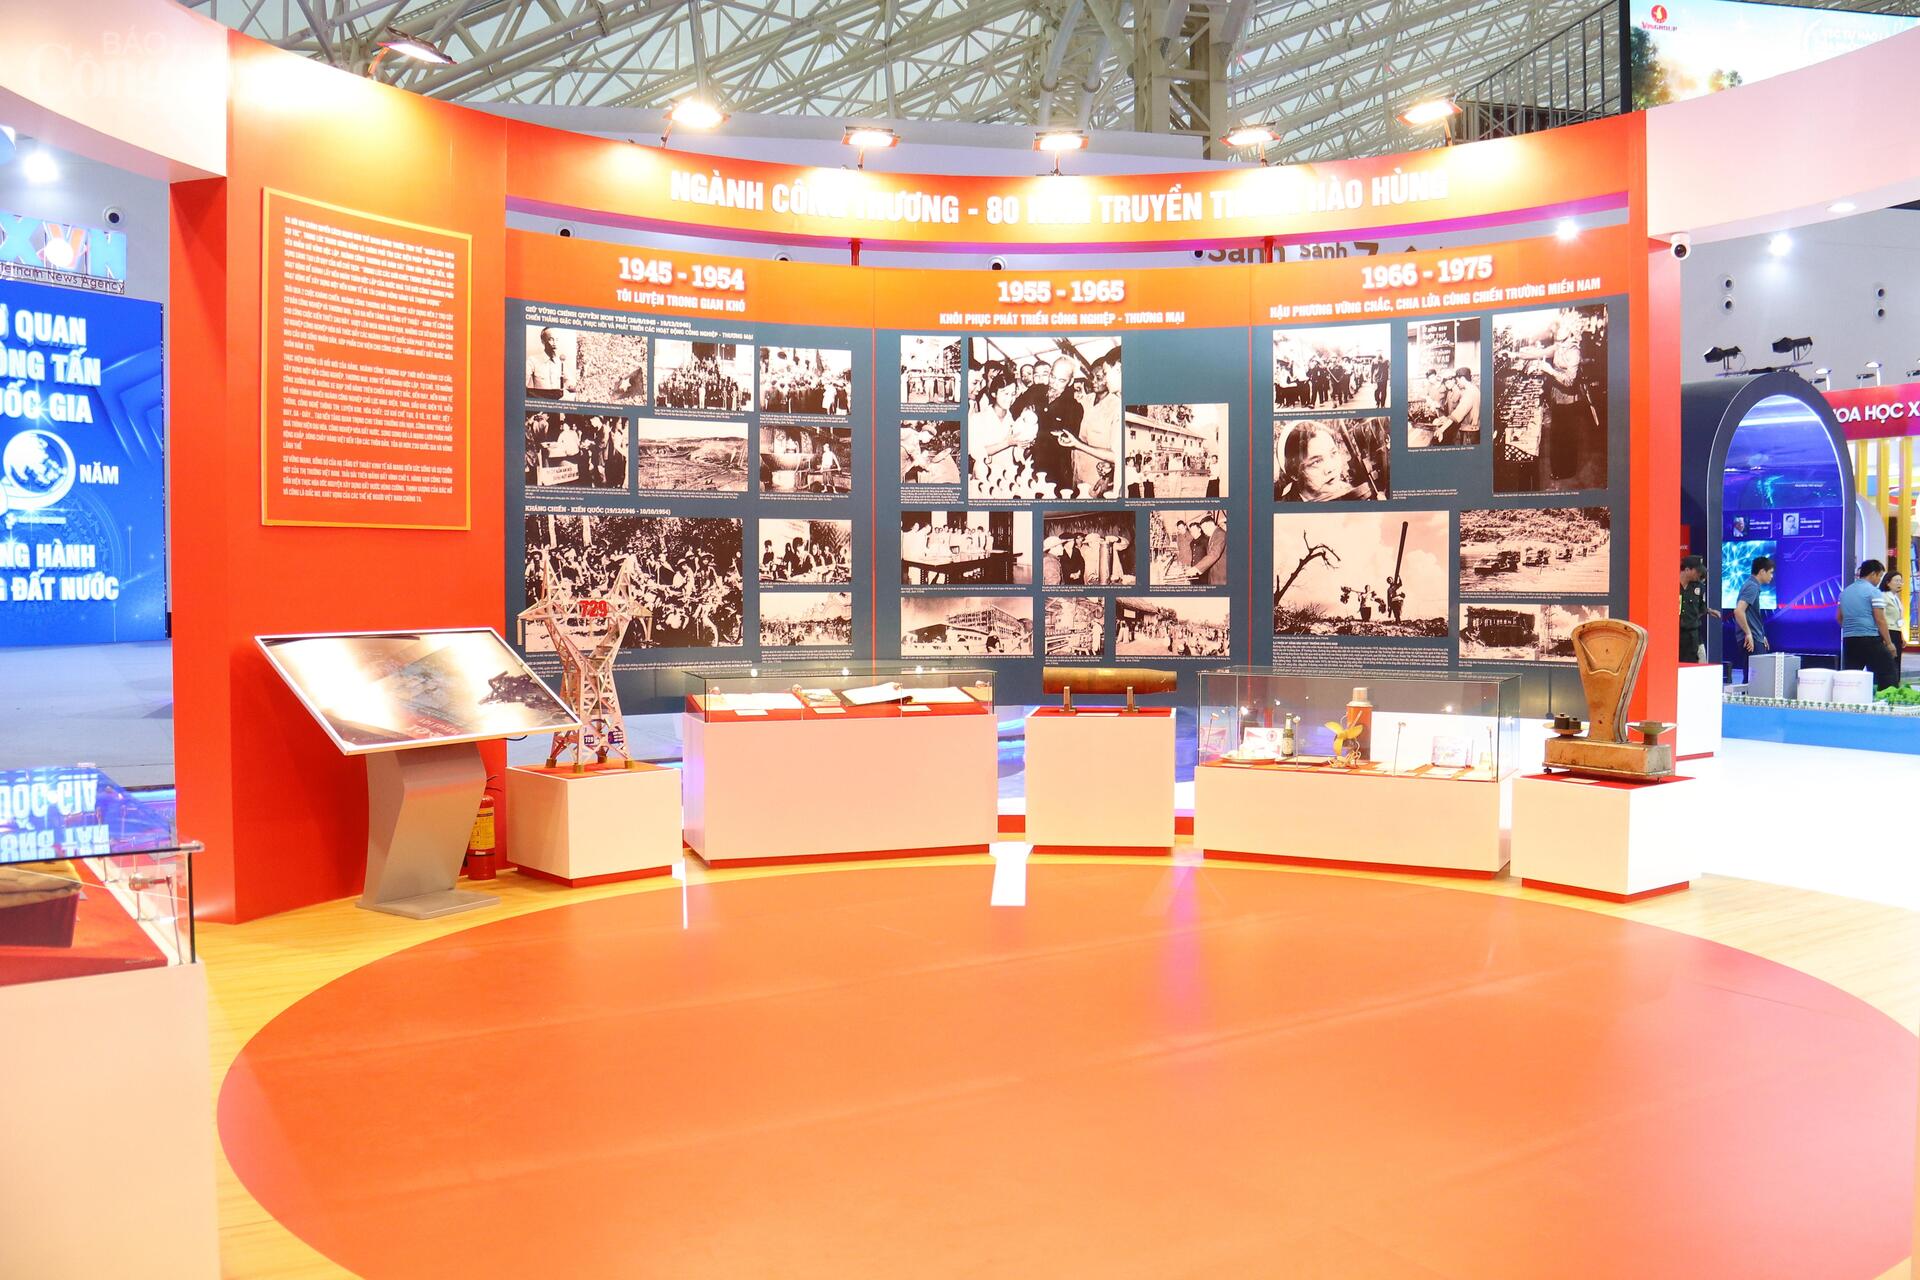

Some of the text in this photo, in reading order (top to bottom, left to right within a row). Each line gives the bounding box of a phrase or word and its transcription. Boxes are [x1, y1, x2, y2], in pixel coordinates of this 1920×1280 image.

[670, 169, 764, 211] NGÀNH
[986, 195, 1019, 224] 80
[1099, 183, 1203, 223] TRUYỀN
[1372, 168, 1449, 207] HÙNG
[47, 270, 77, 285] News
[80, 275, 125, 293] Agency
[618, 256, 673, 284] 1945
[691, 265, 745, 290] 1954
[1361, 264, 1417, 290] 1966
[1437, 255, 1493, 283] 1975
[617, 288, 746, 313] TÔI LUYỆN TRONG GIAN KHÓ
[997, 280, 1052, 303] 1955
[1070, 279, 1125, 302] 1965
[1269, 277, 1601, 320] HẬU PHƯƠNG VỮNG CHẮC, CHIA LỬA CÙNG CHIẾN TRƯỜNG MIỀN NAM
[15, 309, 87, 347] QUAN
[939, 312, 963, 325] KHÔI
[965, 313, 992, 327] PHỤC
[993, 312, 1018, 326] PHÁT
[1020, 311, 1049, 326] TRIỂN
[1051, 312, 1078, 325] CÔNG
[1080, 313, 1116, 327] NGHIỆP
[1125, 311, 1163, 324] THƯƠNG
[1165, 312, 1185, 325] MẠI
[50, 348, 101, 386] TẤN
[50, 392, 94, 424] GIA
[1832, 406, 1862, 423] OA
[1864, 402, 1904, 424] HỌC
[79, 461, 119, 485] NĂM
[525, 505, 547, 513] KHÁNG
[587, 506, 604, 514] QUỐC
[36, 538, 96, 568] HÀNH
[11, 569, 57, 601] ĐẤT
[60, 571, 120, 601] NƯỚC
[577, 600, 608, 617] 729
